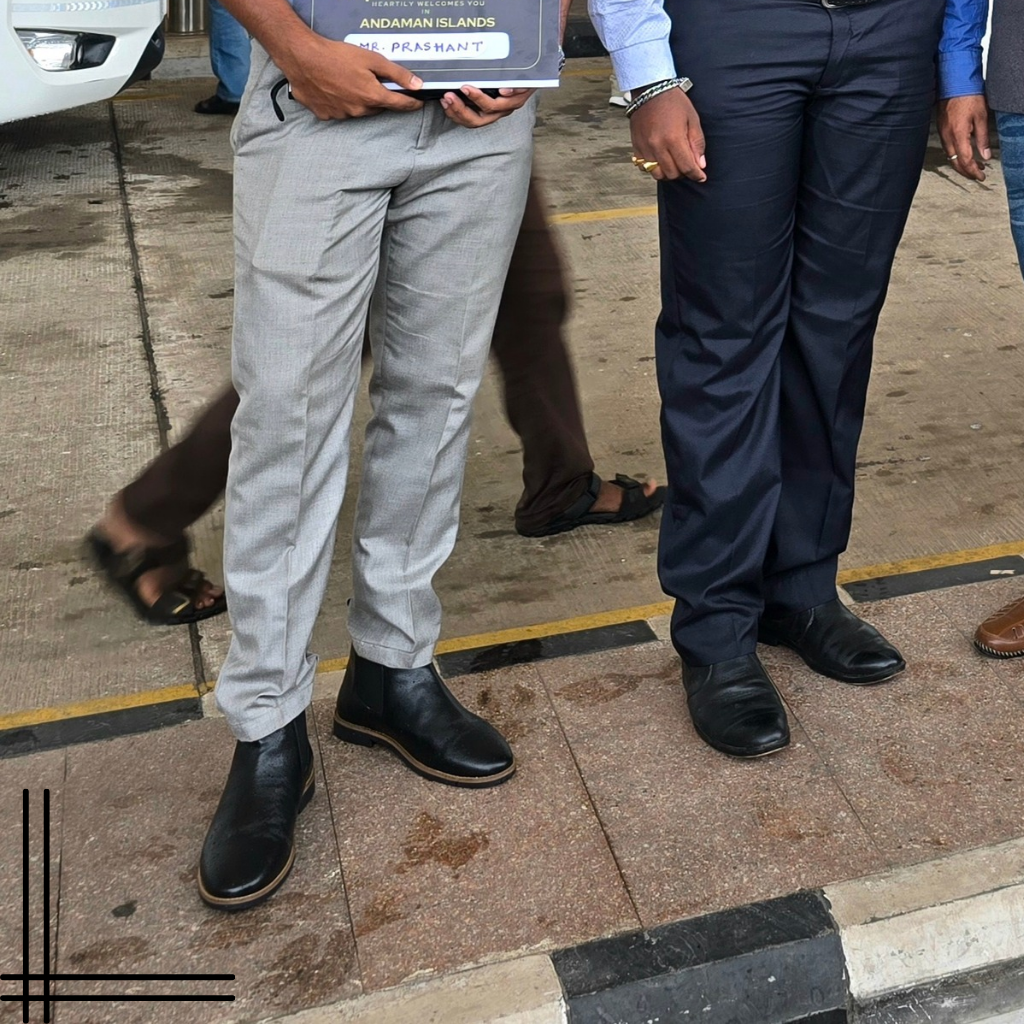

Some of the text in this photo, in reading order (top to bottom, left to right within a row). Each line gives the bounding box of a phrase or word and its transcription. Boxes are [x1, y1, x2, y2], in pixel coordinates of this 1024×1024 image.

[467, 0, 486, 7] YOU
[359, 16, 496, 29] ANDAMAN ISLANDS
[391, 41, 484, 53] PRASHANT
